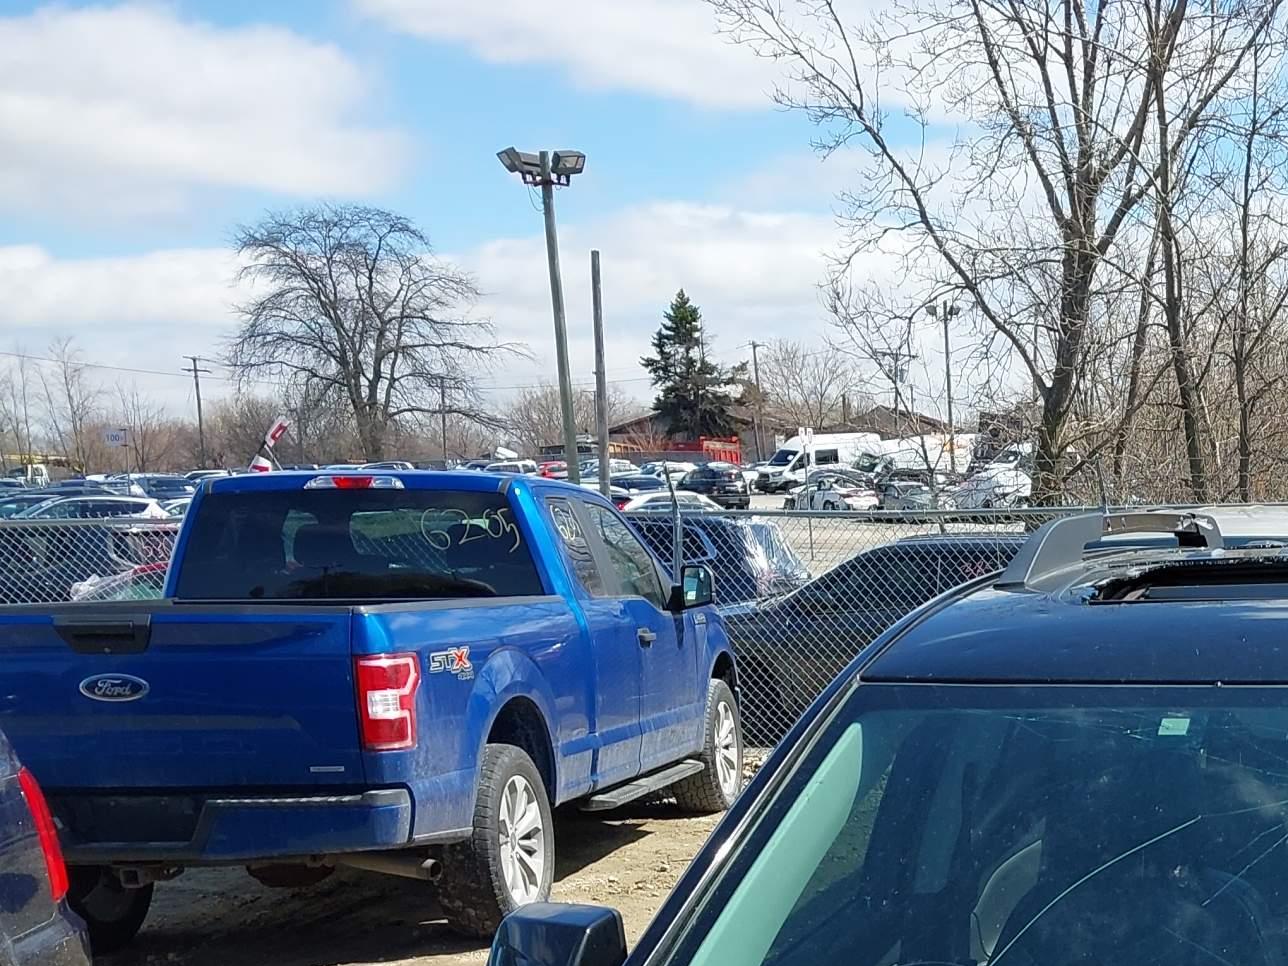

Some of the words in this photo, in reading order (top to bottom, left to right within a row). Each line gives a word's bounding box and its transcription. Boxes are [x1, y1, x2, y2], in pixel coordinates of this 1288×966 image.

[421, 508, 521, 553] 6205
[430, 646, 472, 673] STX
[94, 679, 132, 696] Ford
